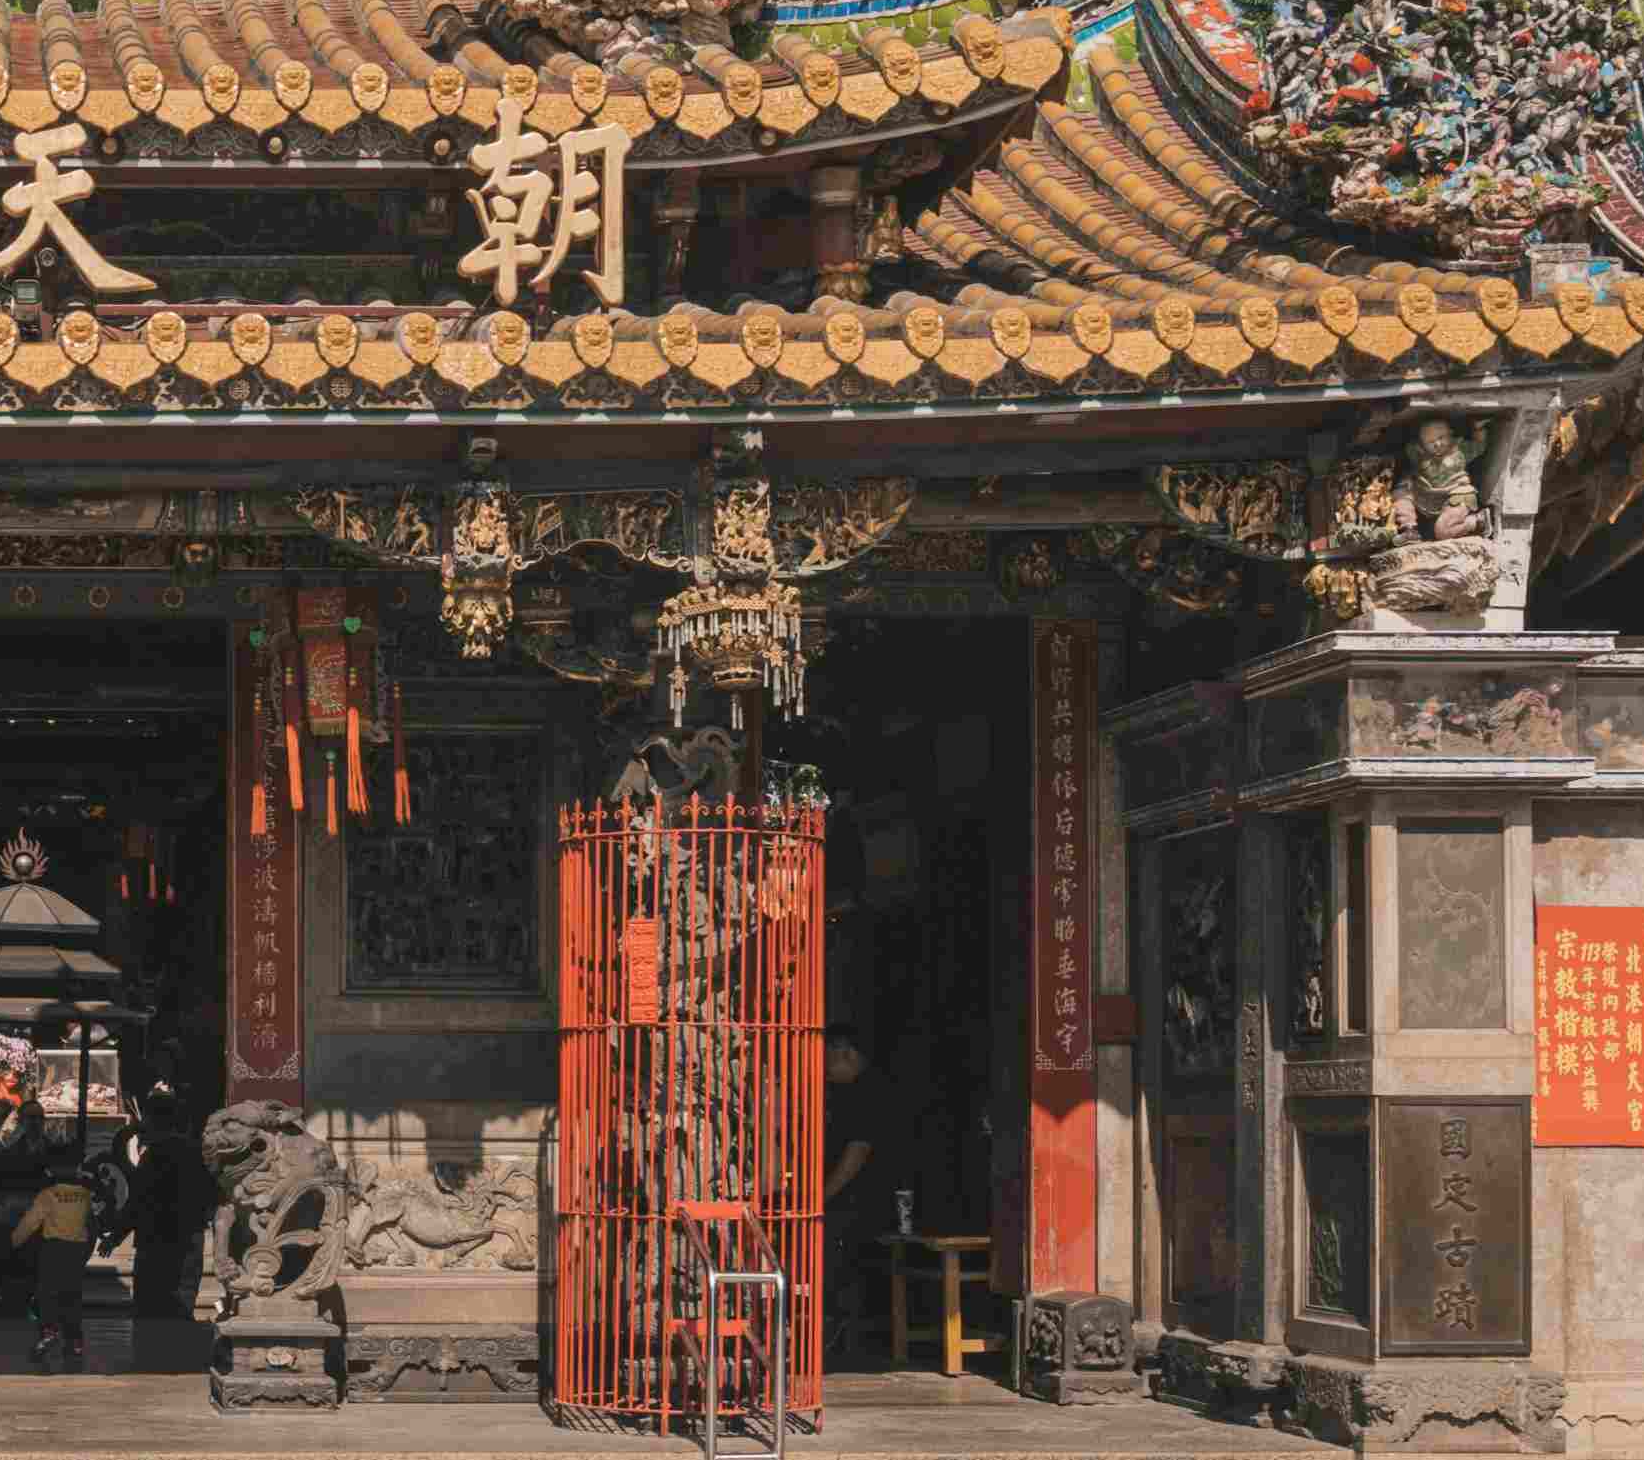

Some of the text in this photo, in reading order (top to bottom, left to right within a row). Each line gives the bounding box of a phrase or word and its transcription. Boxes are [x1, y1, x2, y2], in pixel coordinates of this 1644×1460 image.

[1554, 928, 1580, 1076] 宗教楷模
[1580, 941, 1602, 1113] 113年宗教公益獎
[1601, 941, 1621, 1064] 榮獲內政部
[1625, 943, 1643, 1132] 北港朝天宮
[1432, 1115, 1478, 1330] 國定古蹟
